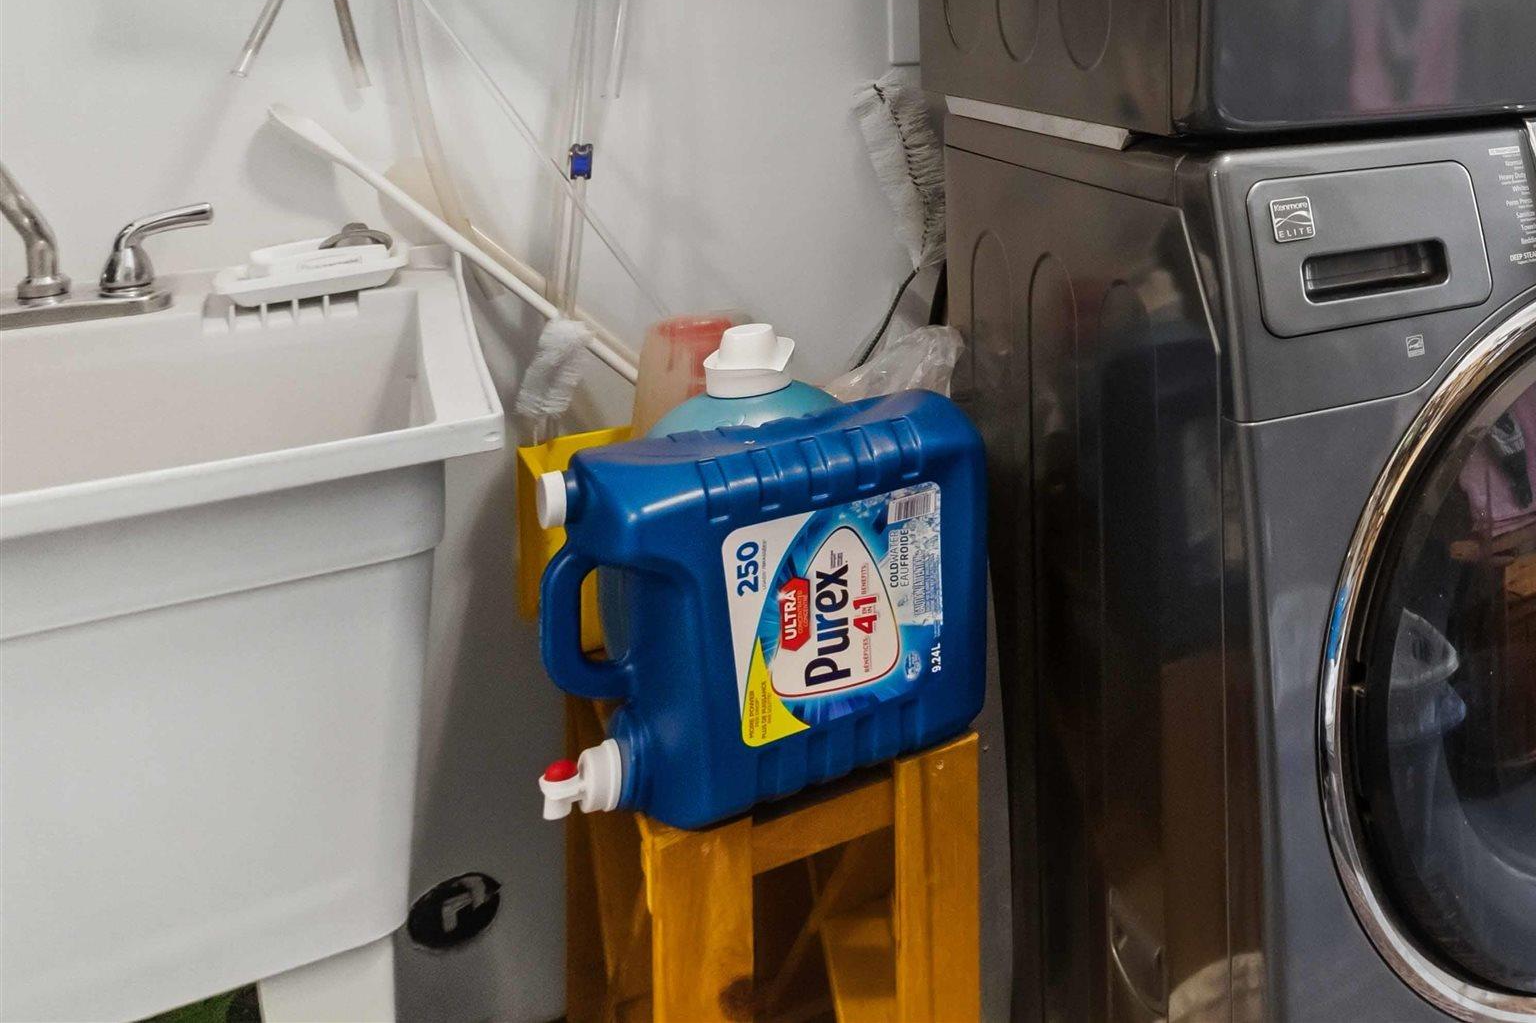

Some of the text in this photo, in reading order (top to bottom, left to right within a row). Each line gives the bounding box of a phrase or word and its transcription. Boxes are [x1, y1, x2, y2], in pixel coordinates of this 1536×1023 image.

[1273, 202, 1308, 212] Kenmore
[1278, 227, 1312, 238] ELITE
[736, 541, 759, 597] 250
[784, 589, 797, 640] ULTRA
[853, 596, 877, 610] 1
[804, 564, 851, 687] Purex
[853, 614, 877, 634] 4
[931, 642, 941, 673] 9.24L
